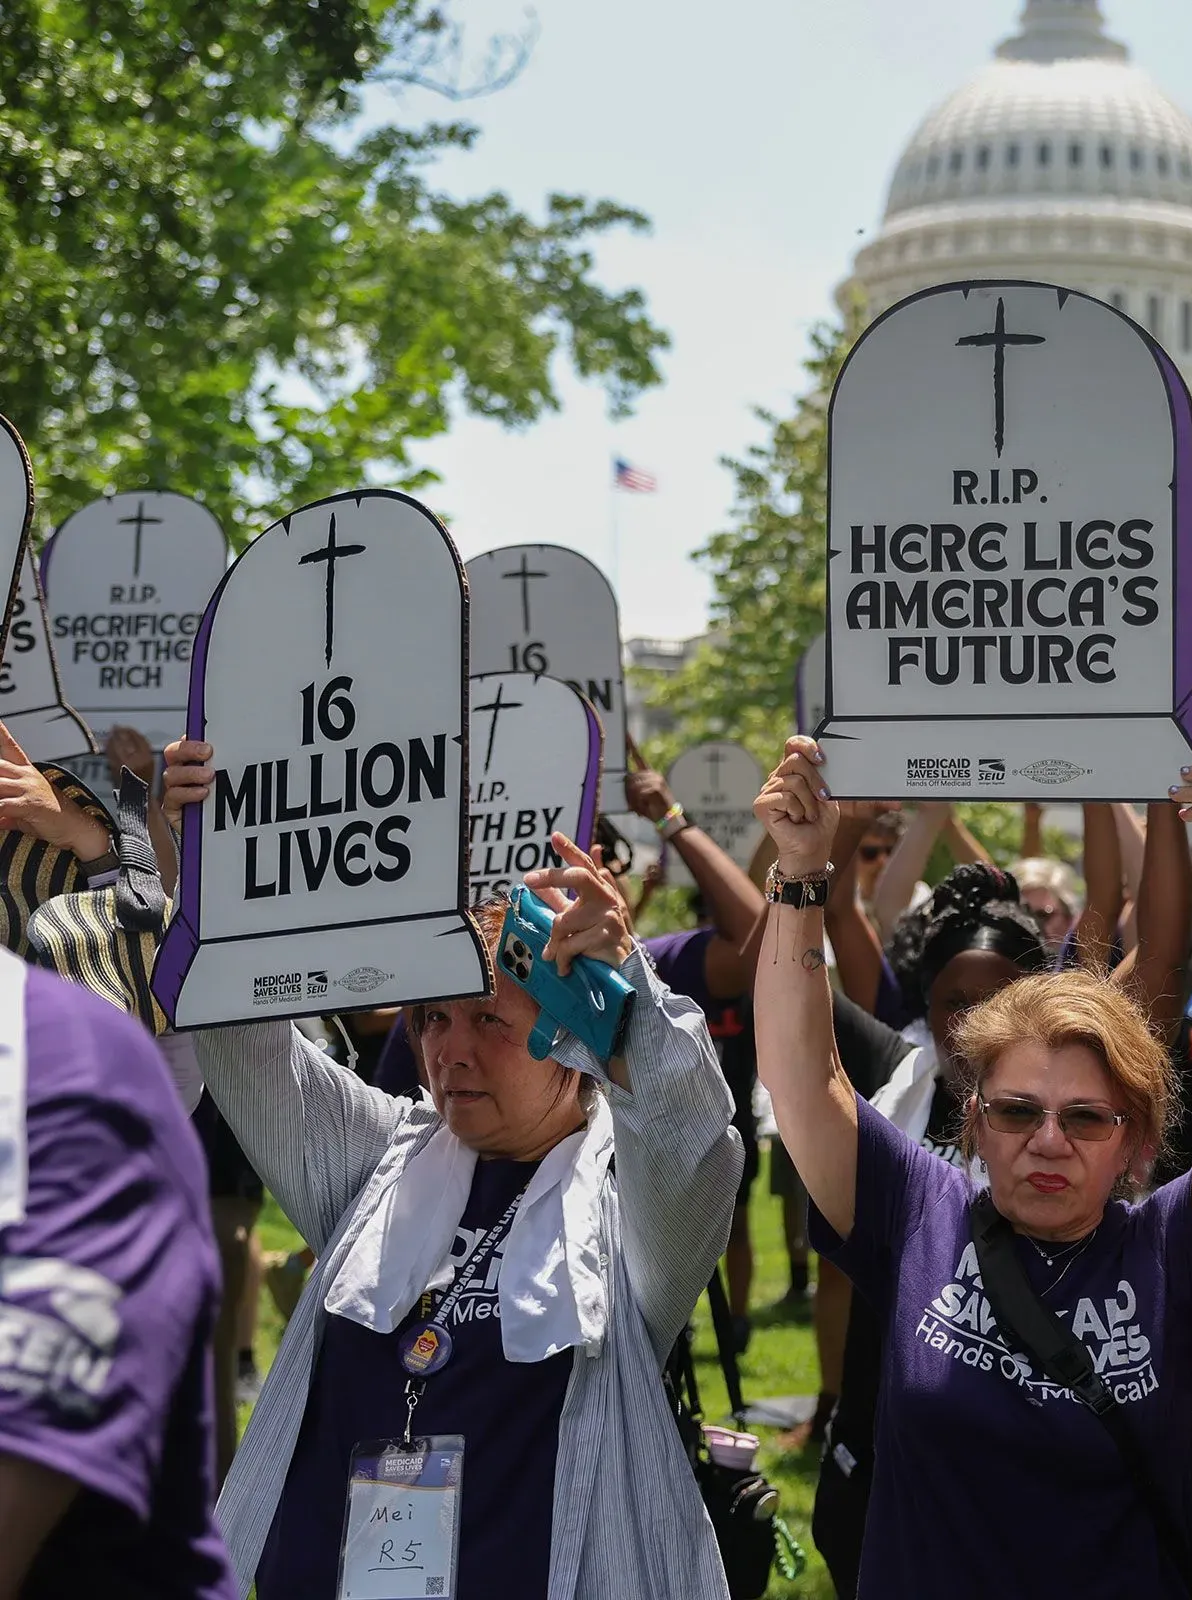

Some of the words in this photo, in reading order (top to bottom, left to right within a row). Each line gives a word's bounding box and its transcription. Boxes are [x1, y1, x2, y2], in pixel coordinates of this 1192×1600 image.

[952, 468, 1048, 505] R.I.P.
[850, 521, 1009, 574] HERE
[1023, 518, 1155, 571] LIES
[109, 585, 161, 604] R.I.P.
[845, 575, 1160, 630] AMERICA'S
[54, 613, 203, 638] SACRIFICE
[73, 640, 129, 664] FOR
[138, 639, 192, 662] THE
[508, 641, 548, 673] 16
[887, 633, 1117, 686] FUTURE
[99, 666, 162, 689] RICH
[300, 675, 356, 746] 16
[906, 758, 971, 769] MEDICAID
[906, 769, 940, 779] SAVES
[941, 769, 971, 779] LIVES
[213, 733, 448, 832] MILLION
[906, 779, 928, 787] Hands
[928, 779, 940, 787] Off
[941, 779, 972, 787] Medicaid
[977, 772, 1006, 781] SEIU
[514, 806, 564, 840] BY
[243, 814, 412, 901] LIVES
[253, 972, 302, 988] MEDICAID
[253, 986, 279, 998] SAVES
[279, 984, 302, 995] LIVES
[306, 984, 328, 995] SEIU
[434, 1263, 477, 1325] MEDICAID
[471, 1225, 504, 1264] SAVES
[499, 1192, 524, 1225] LIVES
[915, 1314, 994, 1372] Hands
[385, 1457, 424, 1467] MEDICAID
[369, 1503, 414, 1523] Mei
